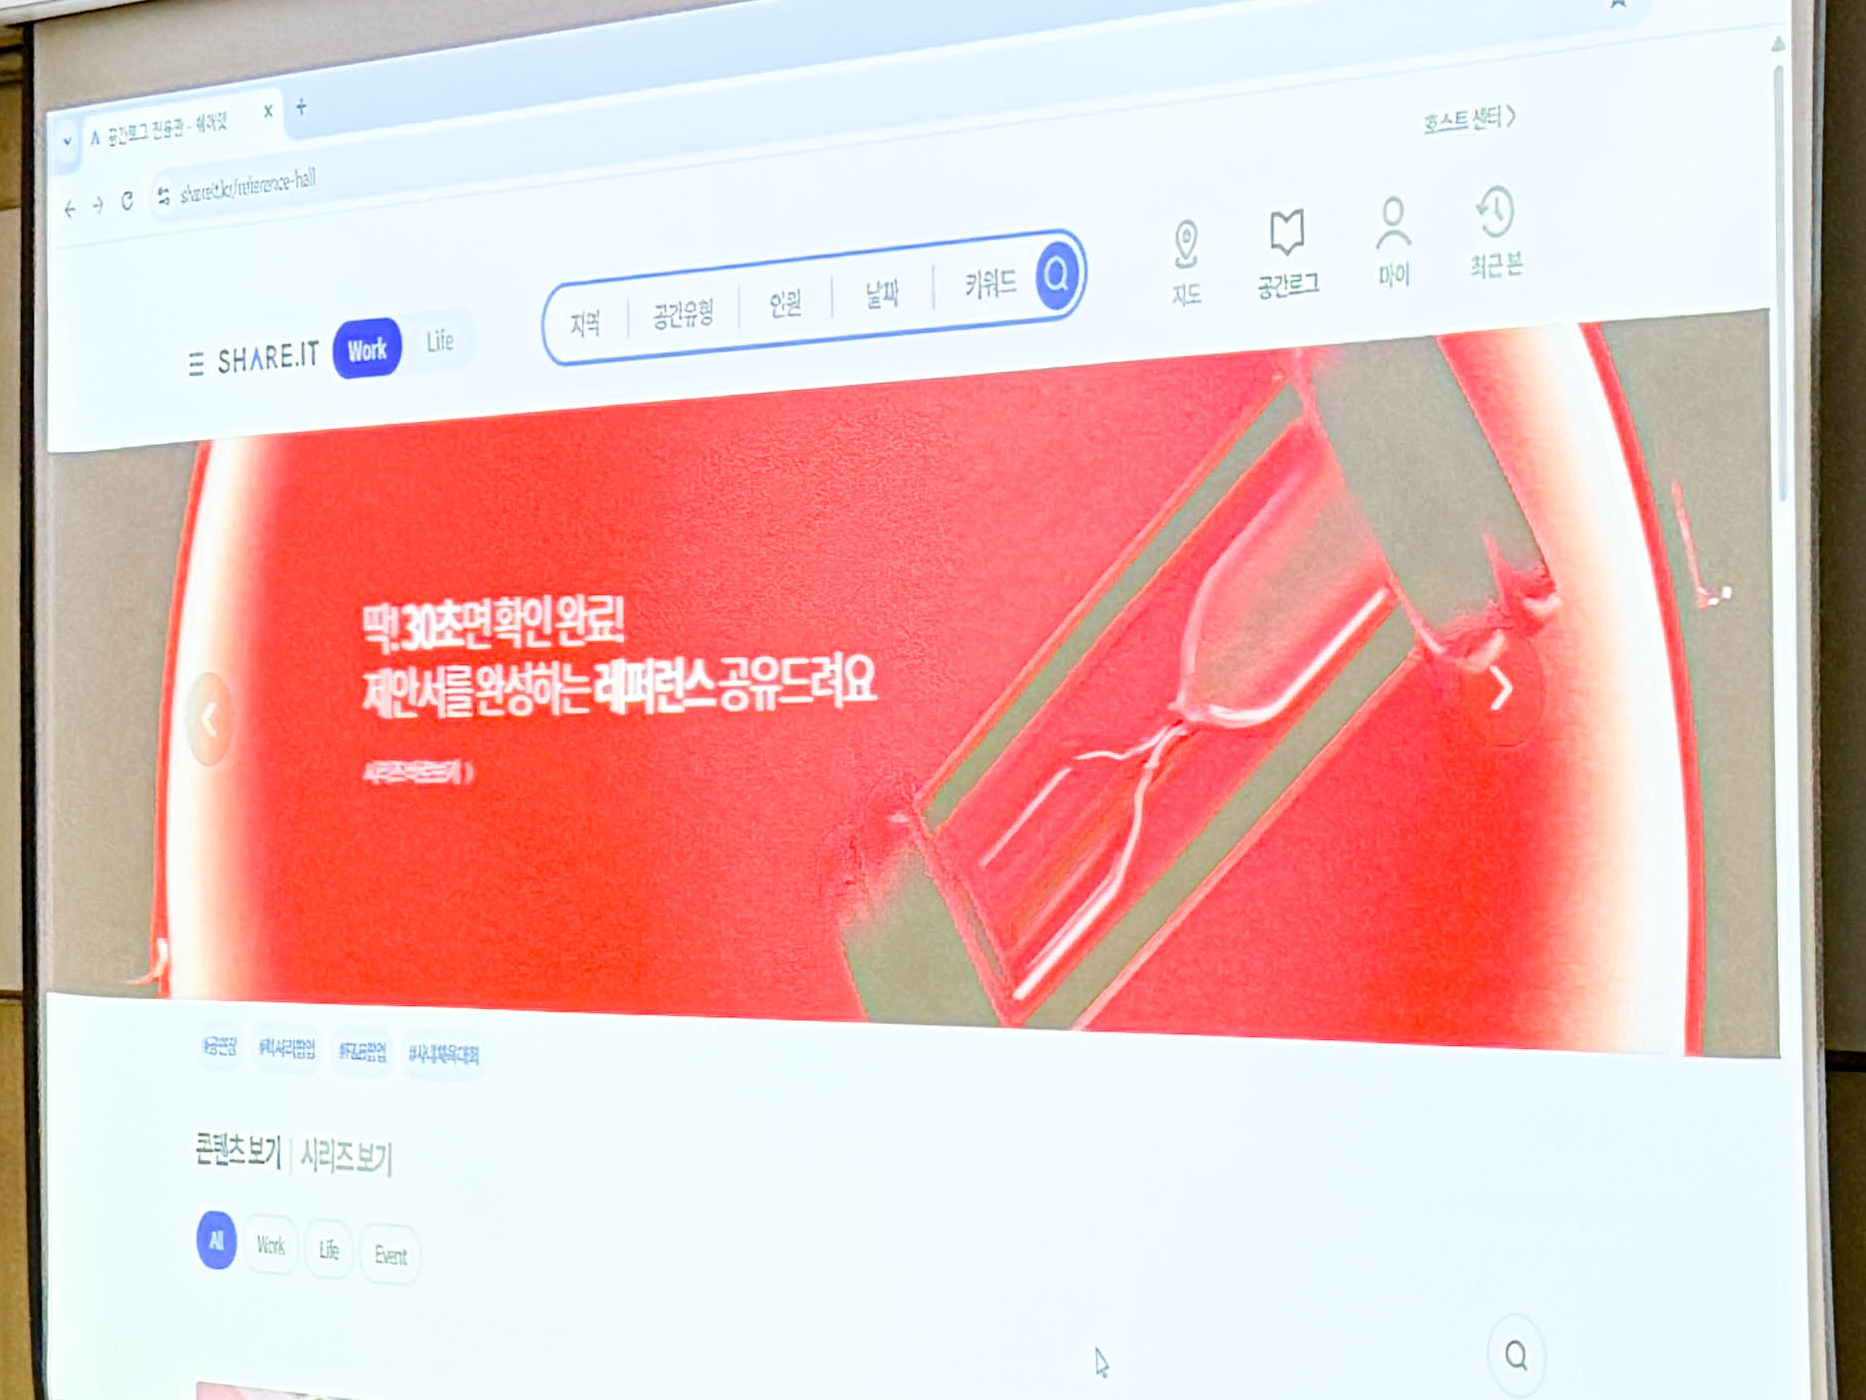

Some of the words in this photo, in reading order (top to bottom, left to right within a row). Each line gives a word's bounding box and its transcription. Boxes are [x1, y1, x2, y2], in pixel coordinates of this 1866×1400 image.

[1423, 110, 1469, 135] 호스트
[1472, 104, 1501, 131] 센터
[1379, 260, 1409, 288] 마이
[1471, 254, 1502, 280] 최근
[1507, 251, 1524, 276] 본
[866, 278, 899, 310] 날짜
[965, 269, 1018, 301] 키워드
[1172, 284, 1202, 306] 지도
[1258, 273, 1320, 300] 공간로그
[653, 299, 714, 331] 공간유형
[770, 289, 801, 319] 인원
[570, 310, 601, 338] 지역
[347, 336, 388, 364] Work
[426, 327, 455, 353] Life
[218, 339, 320, 375] SHARE.IT
[400, 597, 493, 651] 30초면
[493, 594, 553, 650] 확인
[362, 665, 473, 720] 제안서를
[475, 661, 590, 717] 완성하는
[594, 655, 717, 716] 레퍼런스
[718, 651, 879, 713] 공유드려요
[196, 1132, 246, 1166] 콘텐츠
[248, 1134, 281, 1170] 보기
[301, 1137, 354, 1174] 시리즈
[356, 1142, 393, 1178] 보기
[256, 1234, 286, 1256] Work
[319, 1239, 340, 1261] Life
[375, 1244, 409, 1266] Event
